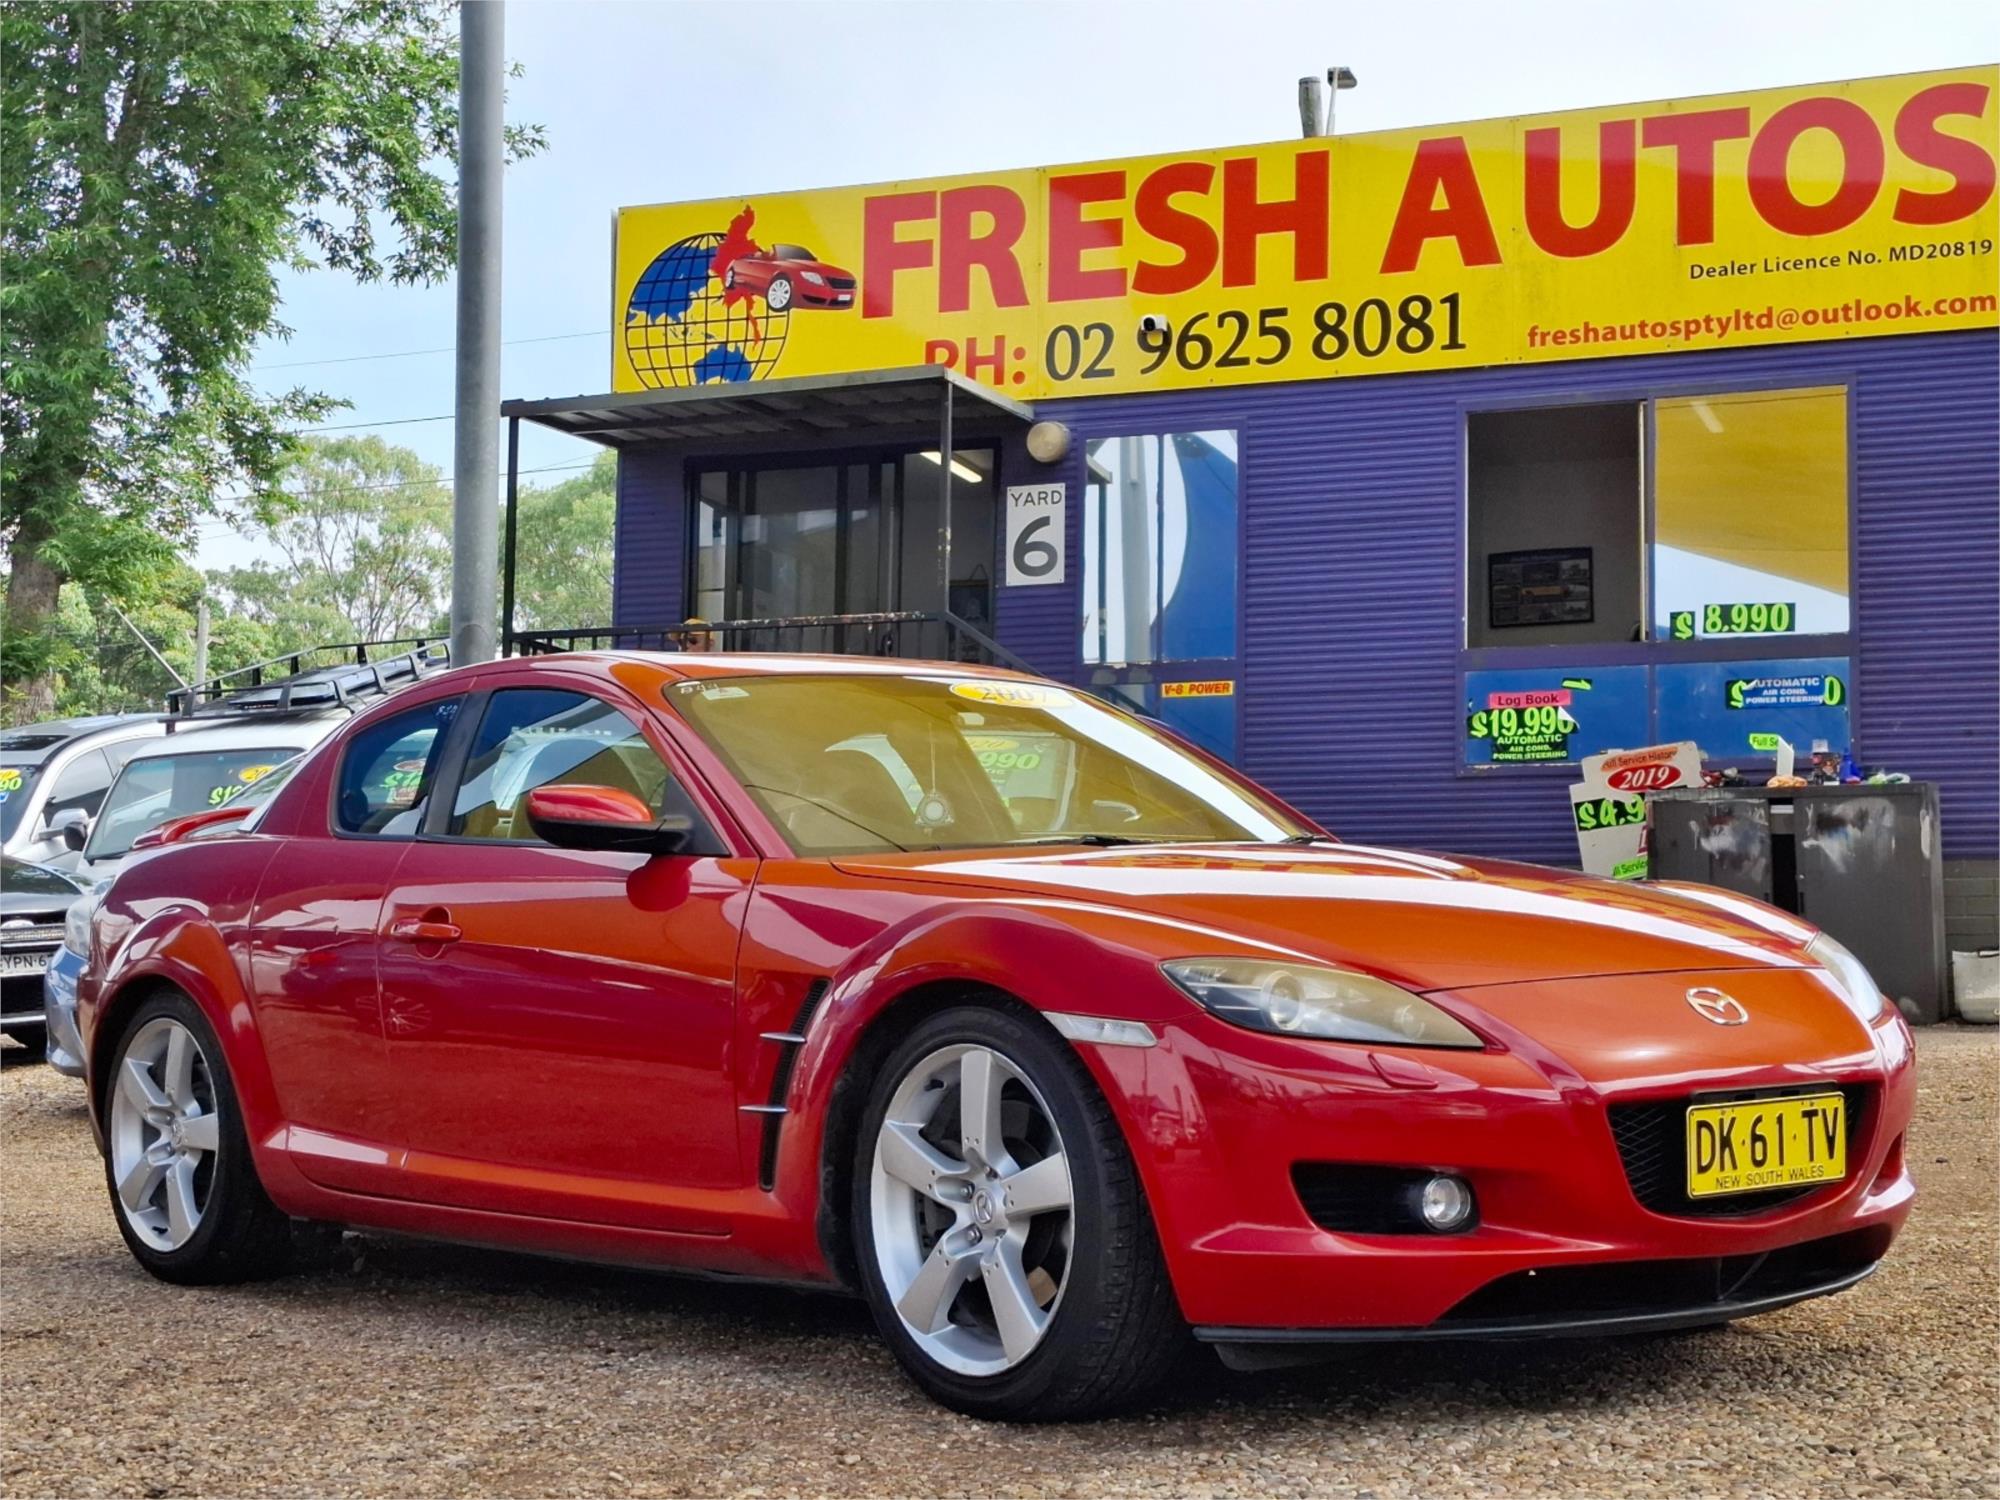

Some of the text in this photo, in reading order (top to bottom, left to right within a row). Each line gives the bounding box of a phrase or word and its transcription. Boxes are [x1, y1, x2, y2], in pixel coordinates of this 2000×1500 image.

[862, 83, 1997, 319] FRESH AUTOS
[1690, 238, 1993, 279] Dealer Licence No. MD20819
[1527, 294, 1997, 348] freshautosptyltd@outlook.com
[925, 292, 1466, 386] PH: 02 9625 8081
[1010, 490, 1063, 507] YARD
[1013, 515, 1058, 577] 6
[1164, 682, 1231, 695] V-8 POWER
[1497, 693, 1559, 706] Log Book
[1497, 734, 1563, 745] AUTOMATIC
[1619, 766, 1670, 788] 2019
[1715, 1165, 1825, 1190] NEW SOUTH WALES
